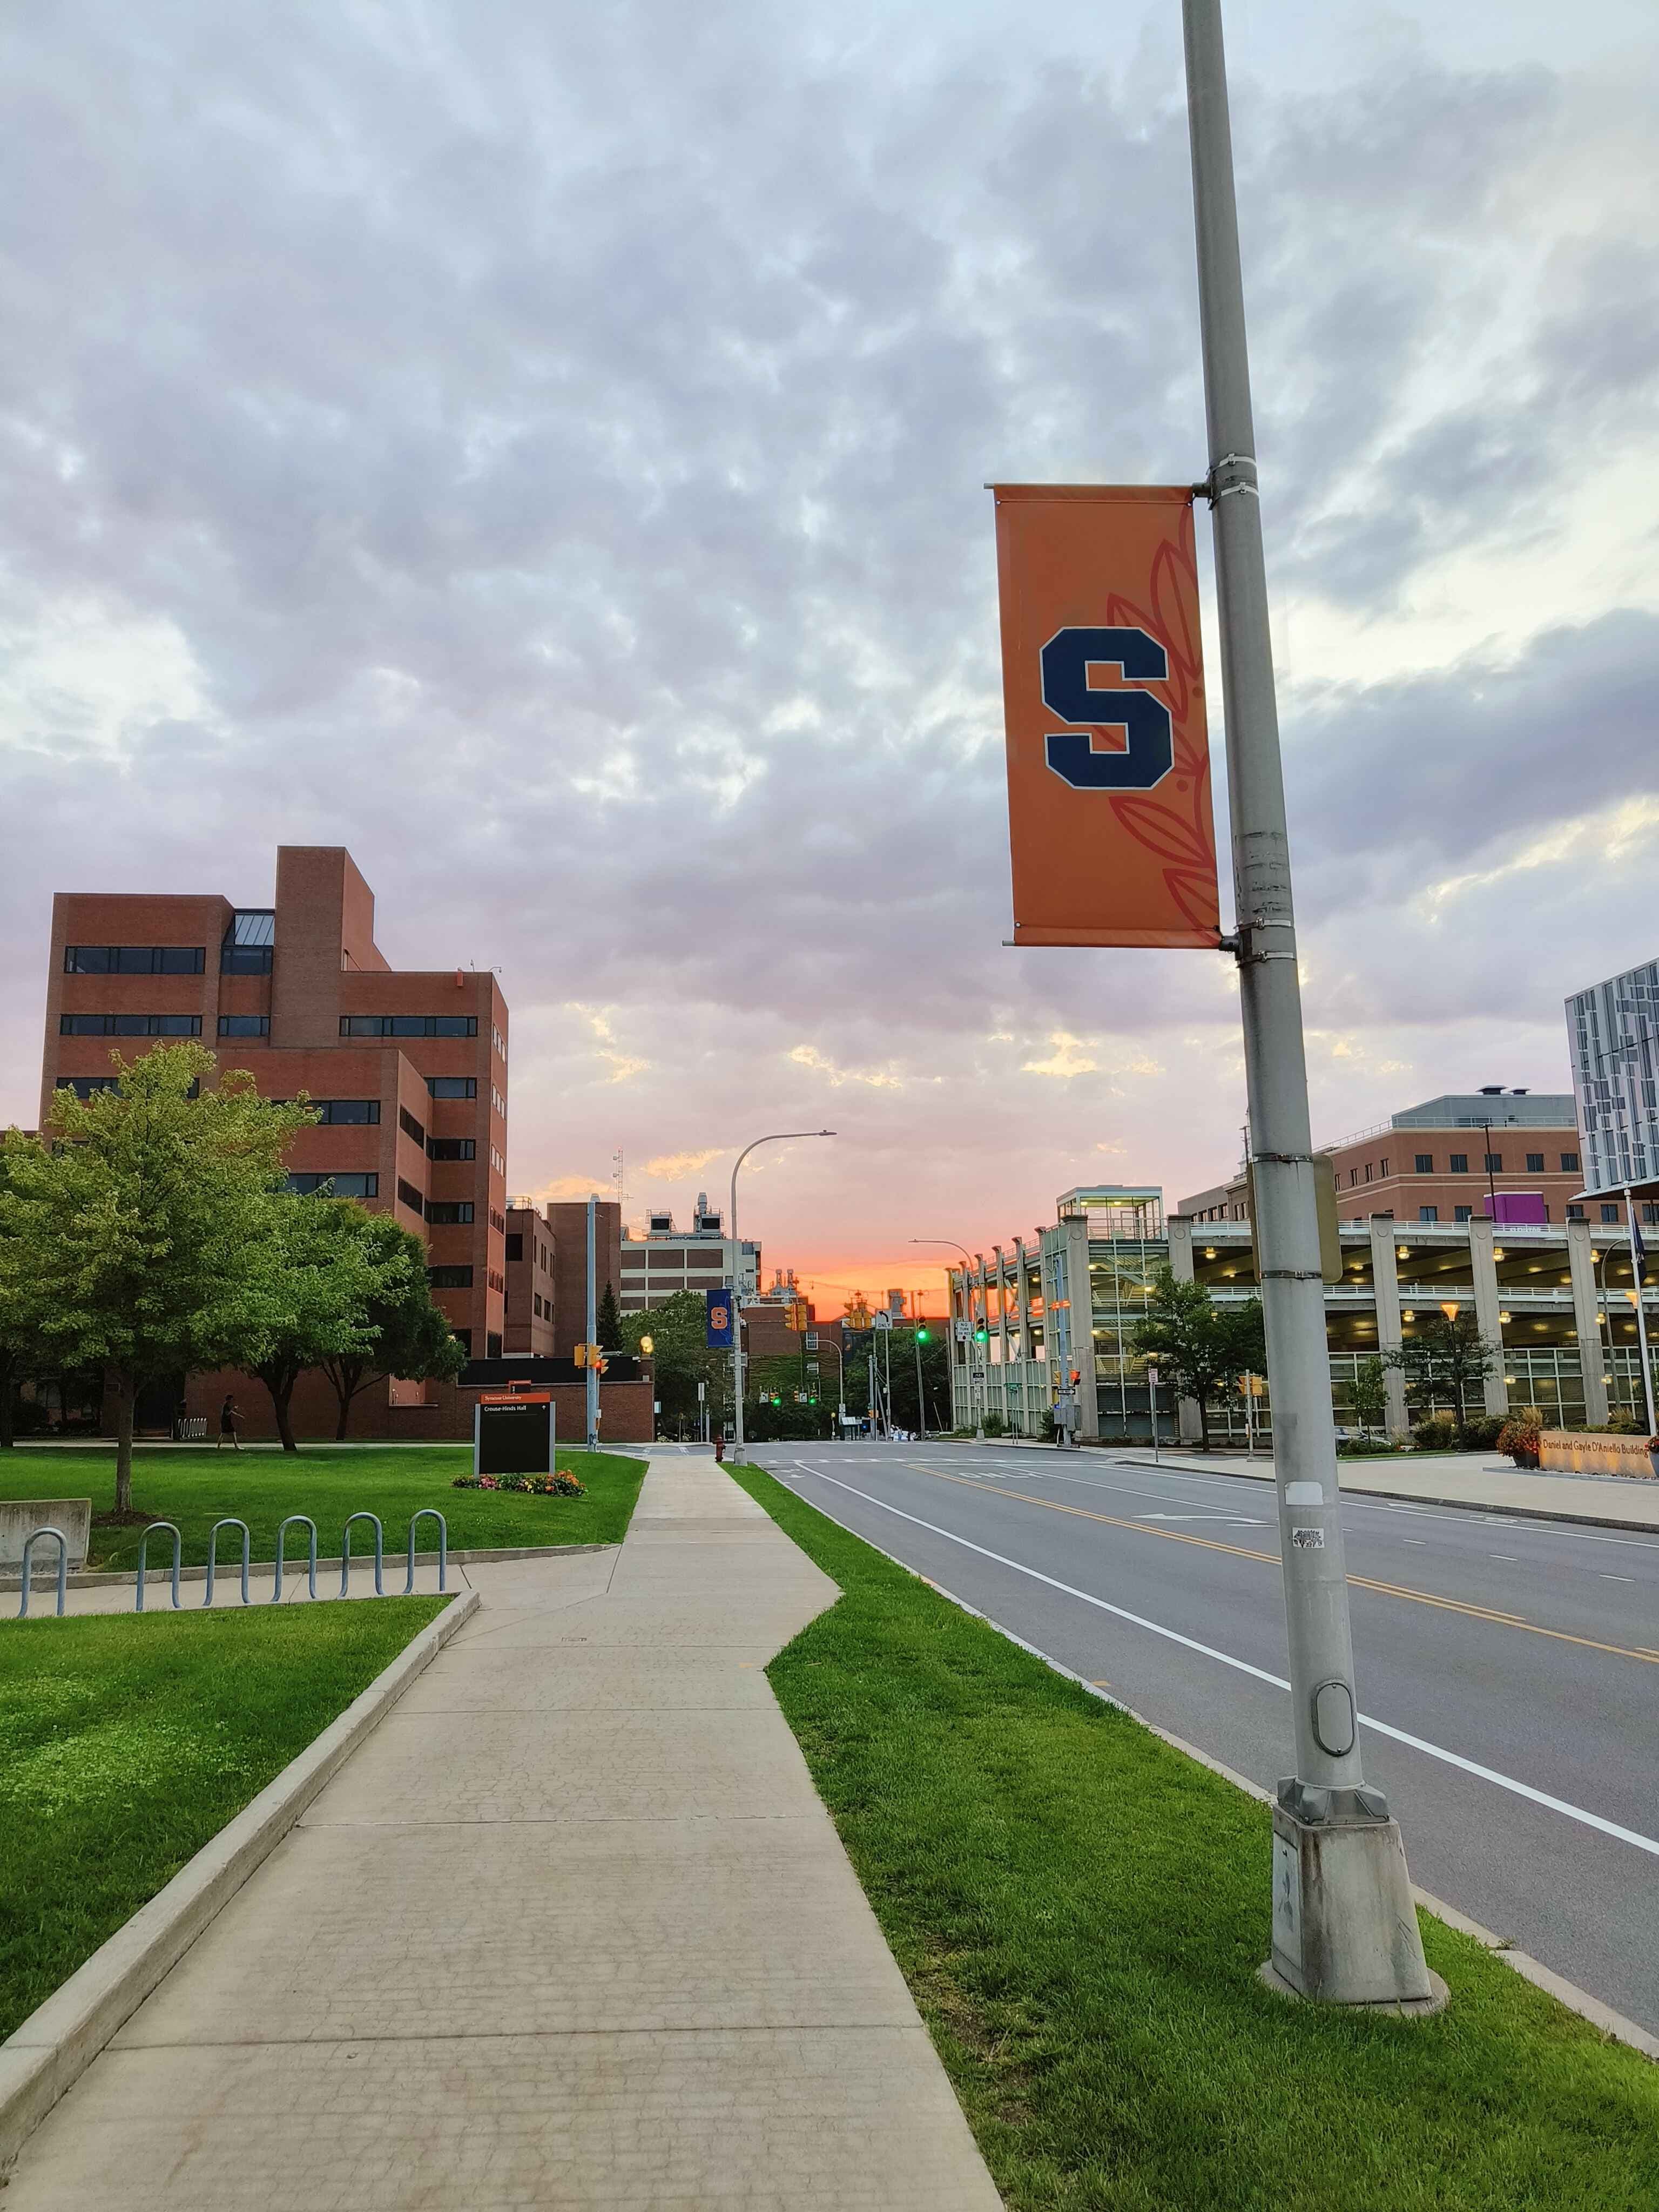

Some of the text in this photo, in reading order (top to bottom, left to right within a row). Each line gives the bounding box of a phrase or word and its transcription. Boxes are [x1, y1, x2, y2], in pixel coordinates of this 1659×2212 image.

[1039, 626, 1175, 790] S
[711, 1307, 727, 1329] S
[1543, 1439, 1649, 1458] Daniel and Gayle D'Aniello Building
